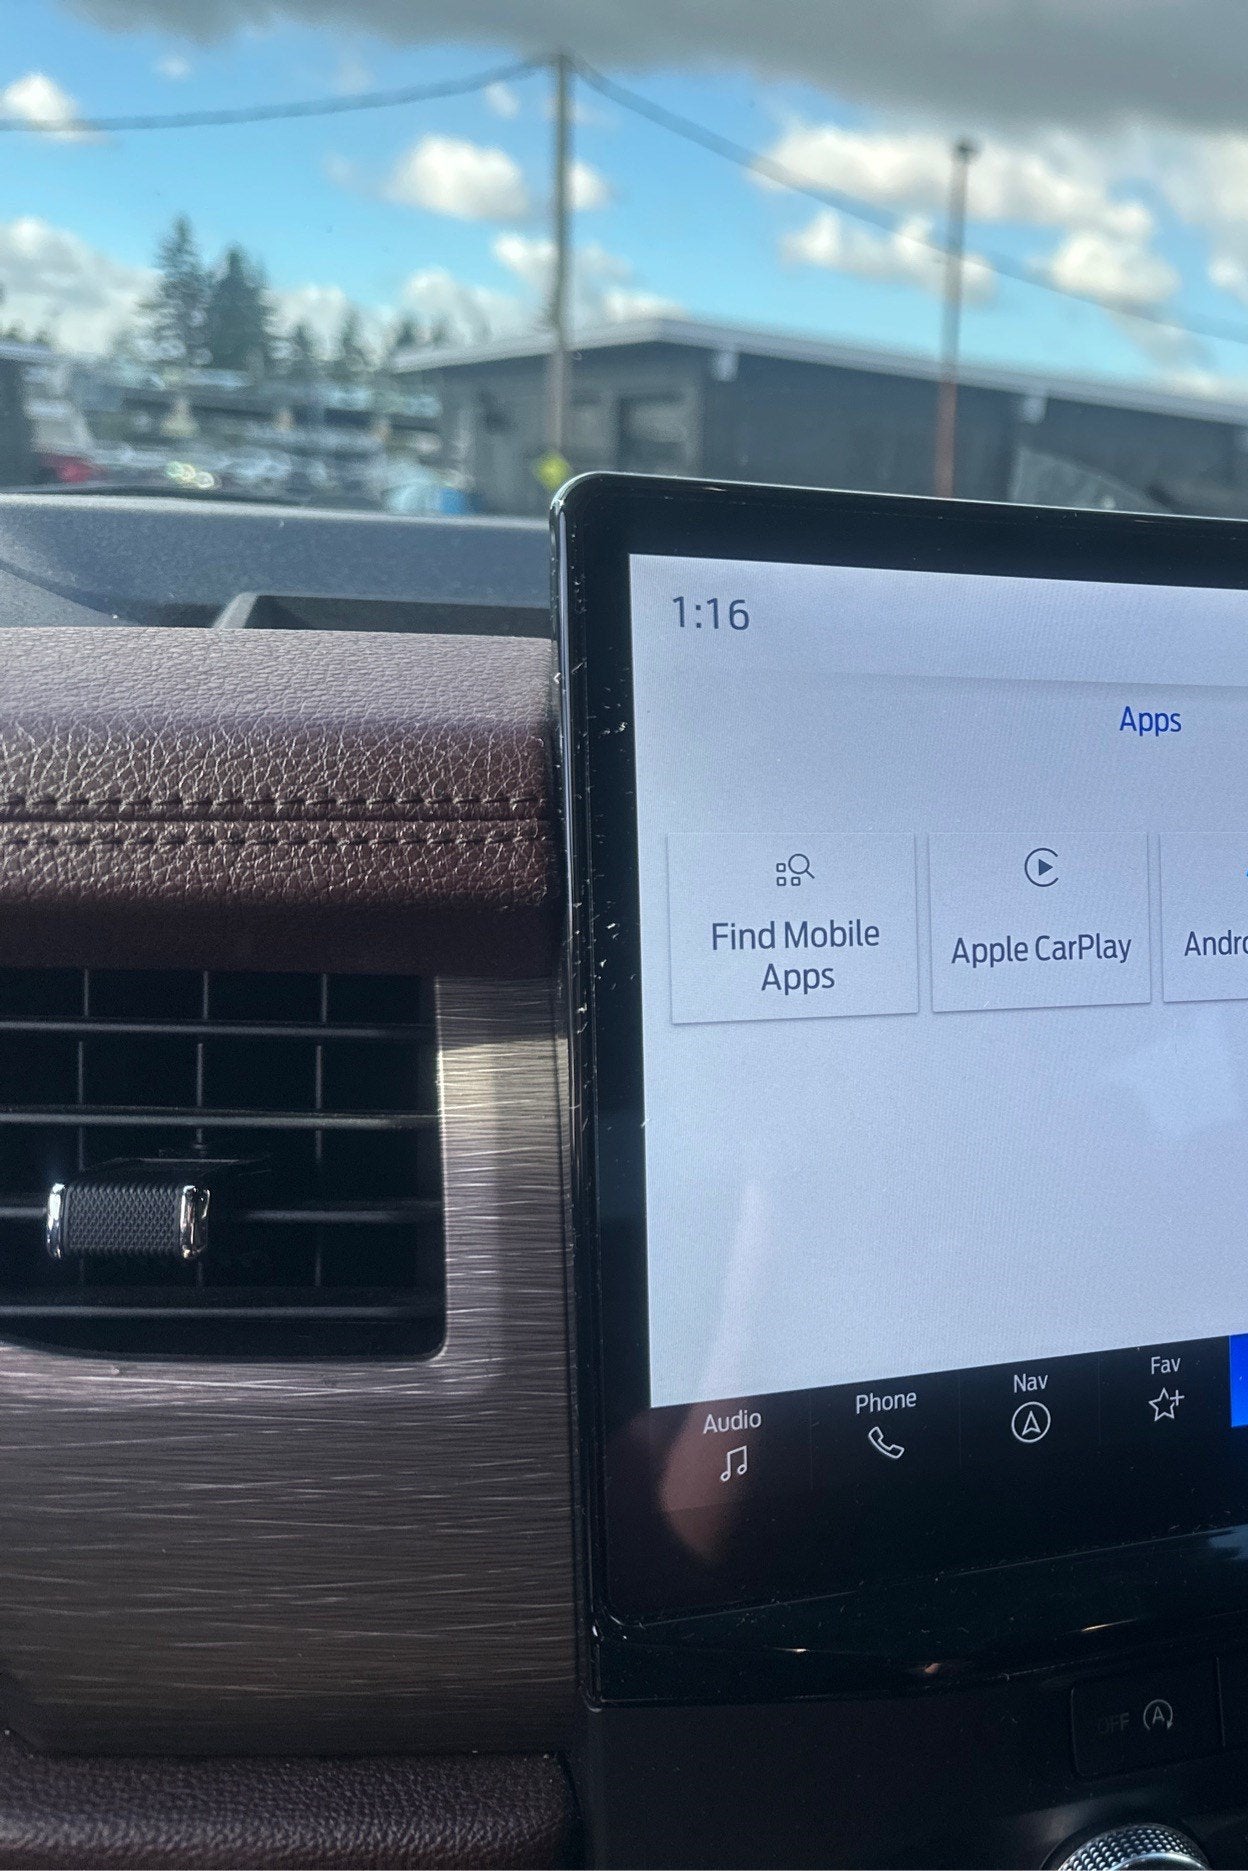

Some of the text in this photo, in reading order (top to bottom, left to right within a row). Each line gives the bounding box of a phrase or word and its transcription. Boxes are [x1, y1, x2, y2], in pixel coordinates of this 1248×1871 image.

[673, 596, 750, 631] 1:16
[1119, 705, 1182, 737] Apps
[712, 918, 880, 951] Find Mobile
[951, 932, 1132, 969] Apple CarPlay
[761, 963, 835, 996] Apps
[1150, 1355, 1181, 1375] Fav
[1013, 1373, 1049, 1393] Nav
[855, 1392, 917, 1415] Phone
[702, 1409, 762, 1435] Audio
